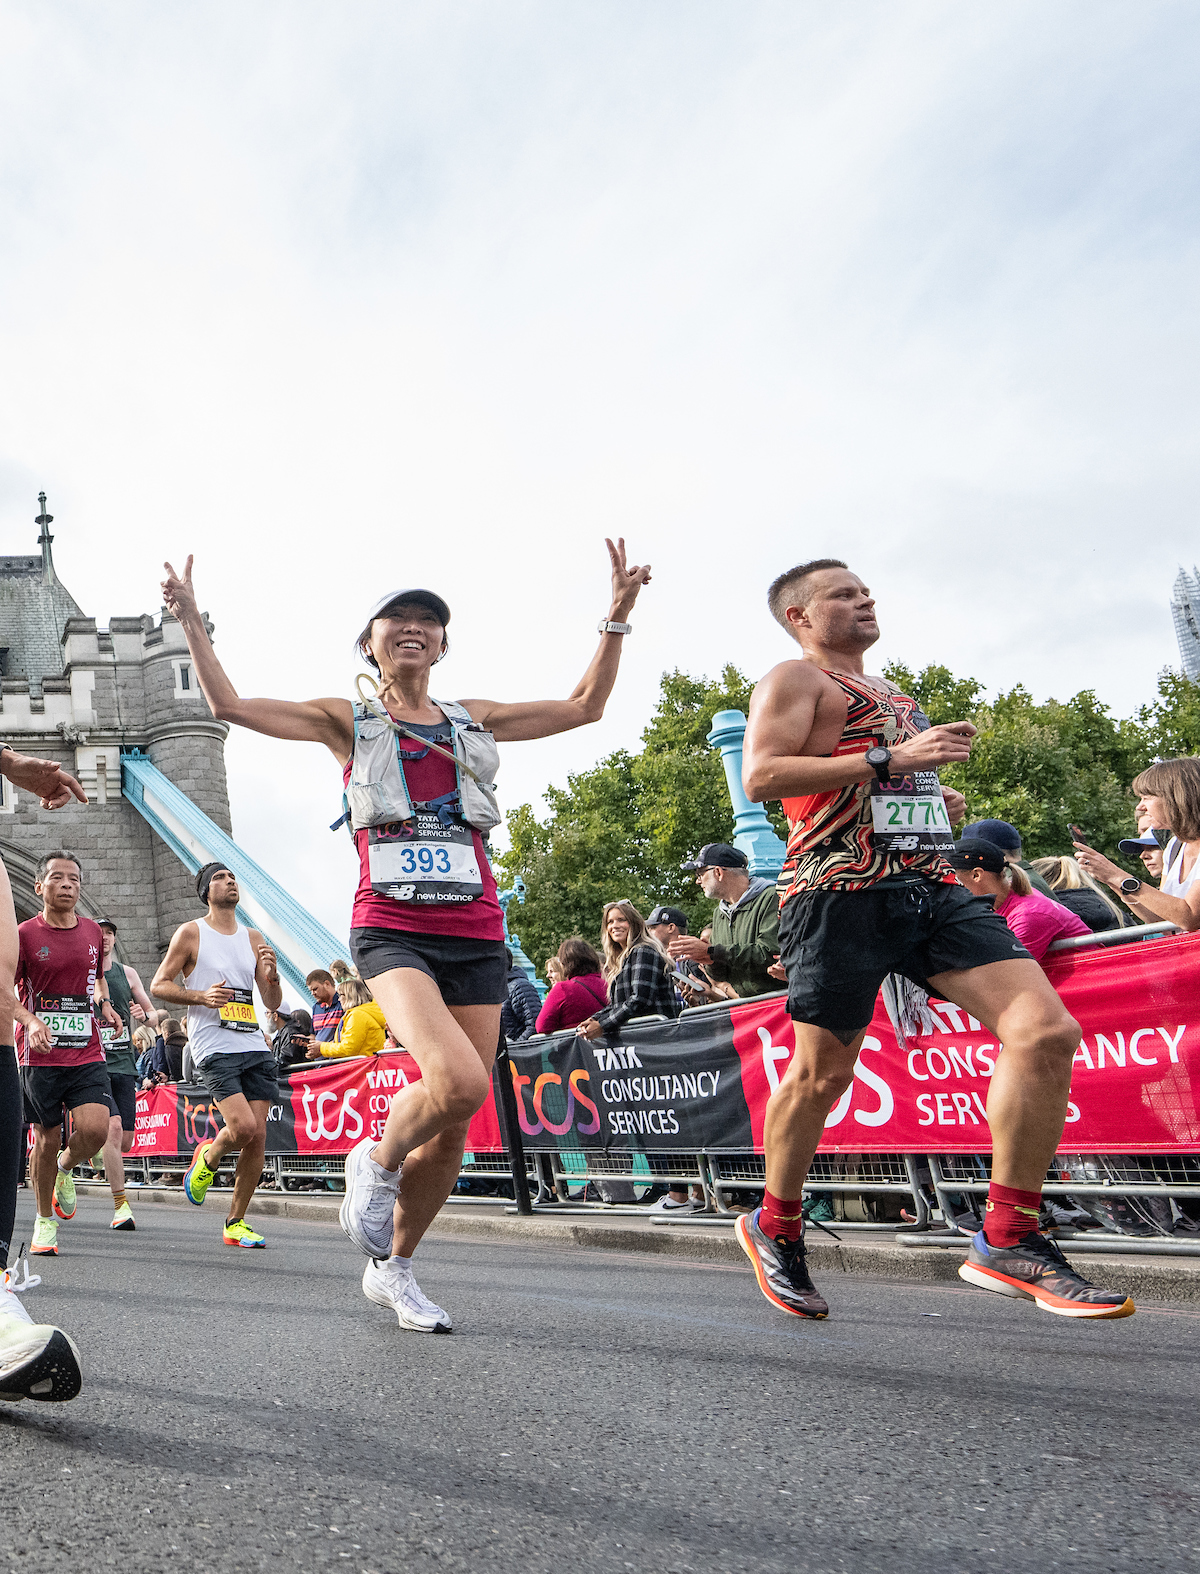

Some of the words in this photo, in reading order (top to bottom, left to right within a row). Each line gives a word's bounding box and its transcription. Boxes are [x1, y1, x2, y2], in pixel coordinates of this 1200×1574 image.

[418, 830, 452, 838] SERVICES
[935, 842, 955, 850] balan
[400, 848, 451, 873] 393
[416, 892, 436, 900] new
[437, 891, 474, 902] balance
[41, 997, 59, 1010] tcs
[223, 1005, 252, 1019] 31180
[43, 1016, 85, 1032] 25745
[593, 1046, 643, 1071] TATA
[908, 1025, 1187, 1082] CONSANCY
[366, 1069, 409, 1089] TATA
[601, 1070, 720, 1104] CONSULTANCY
[757, 1027, 895, 1128] ts
[509, 1060, 600, 1135] tcs
[918, 1090, 1081, 1126] SERVS
[302, 1084, 364, 1141] tcs
[608, 1109, 680, 1135] SERVICES
